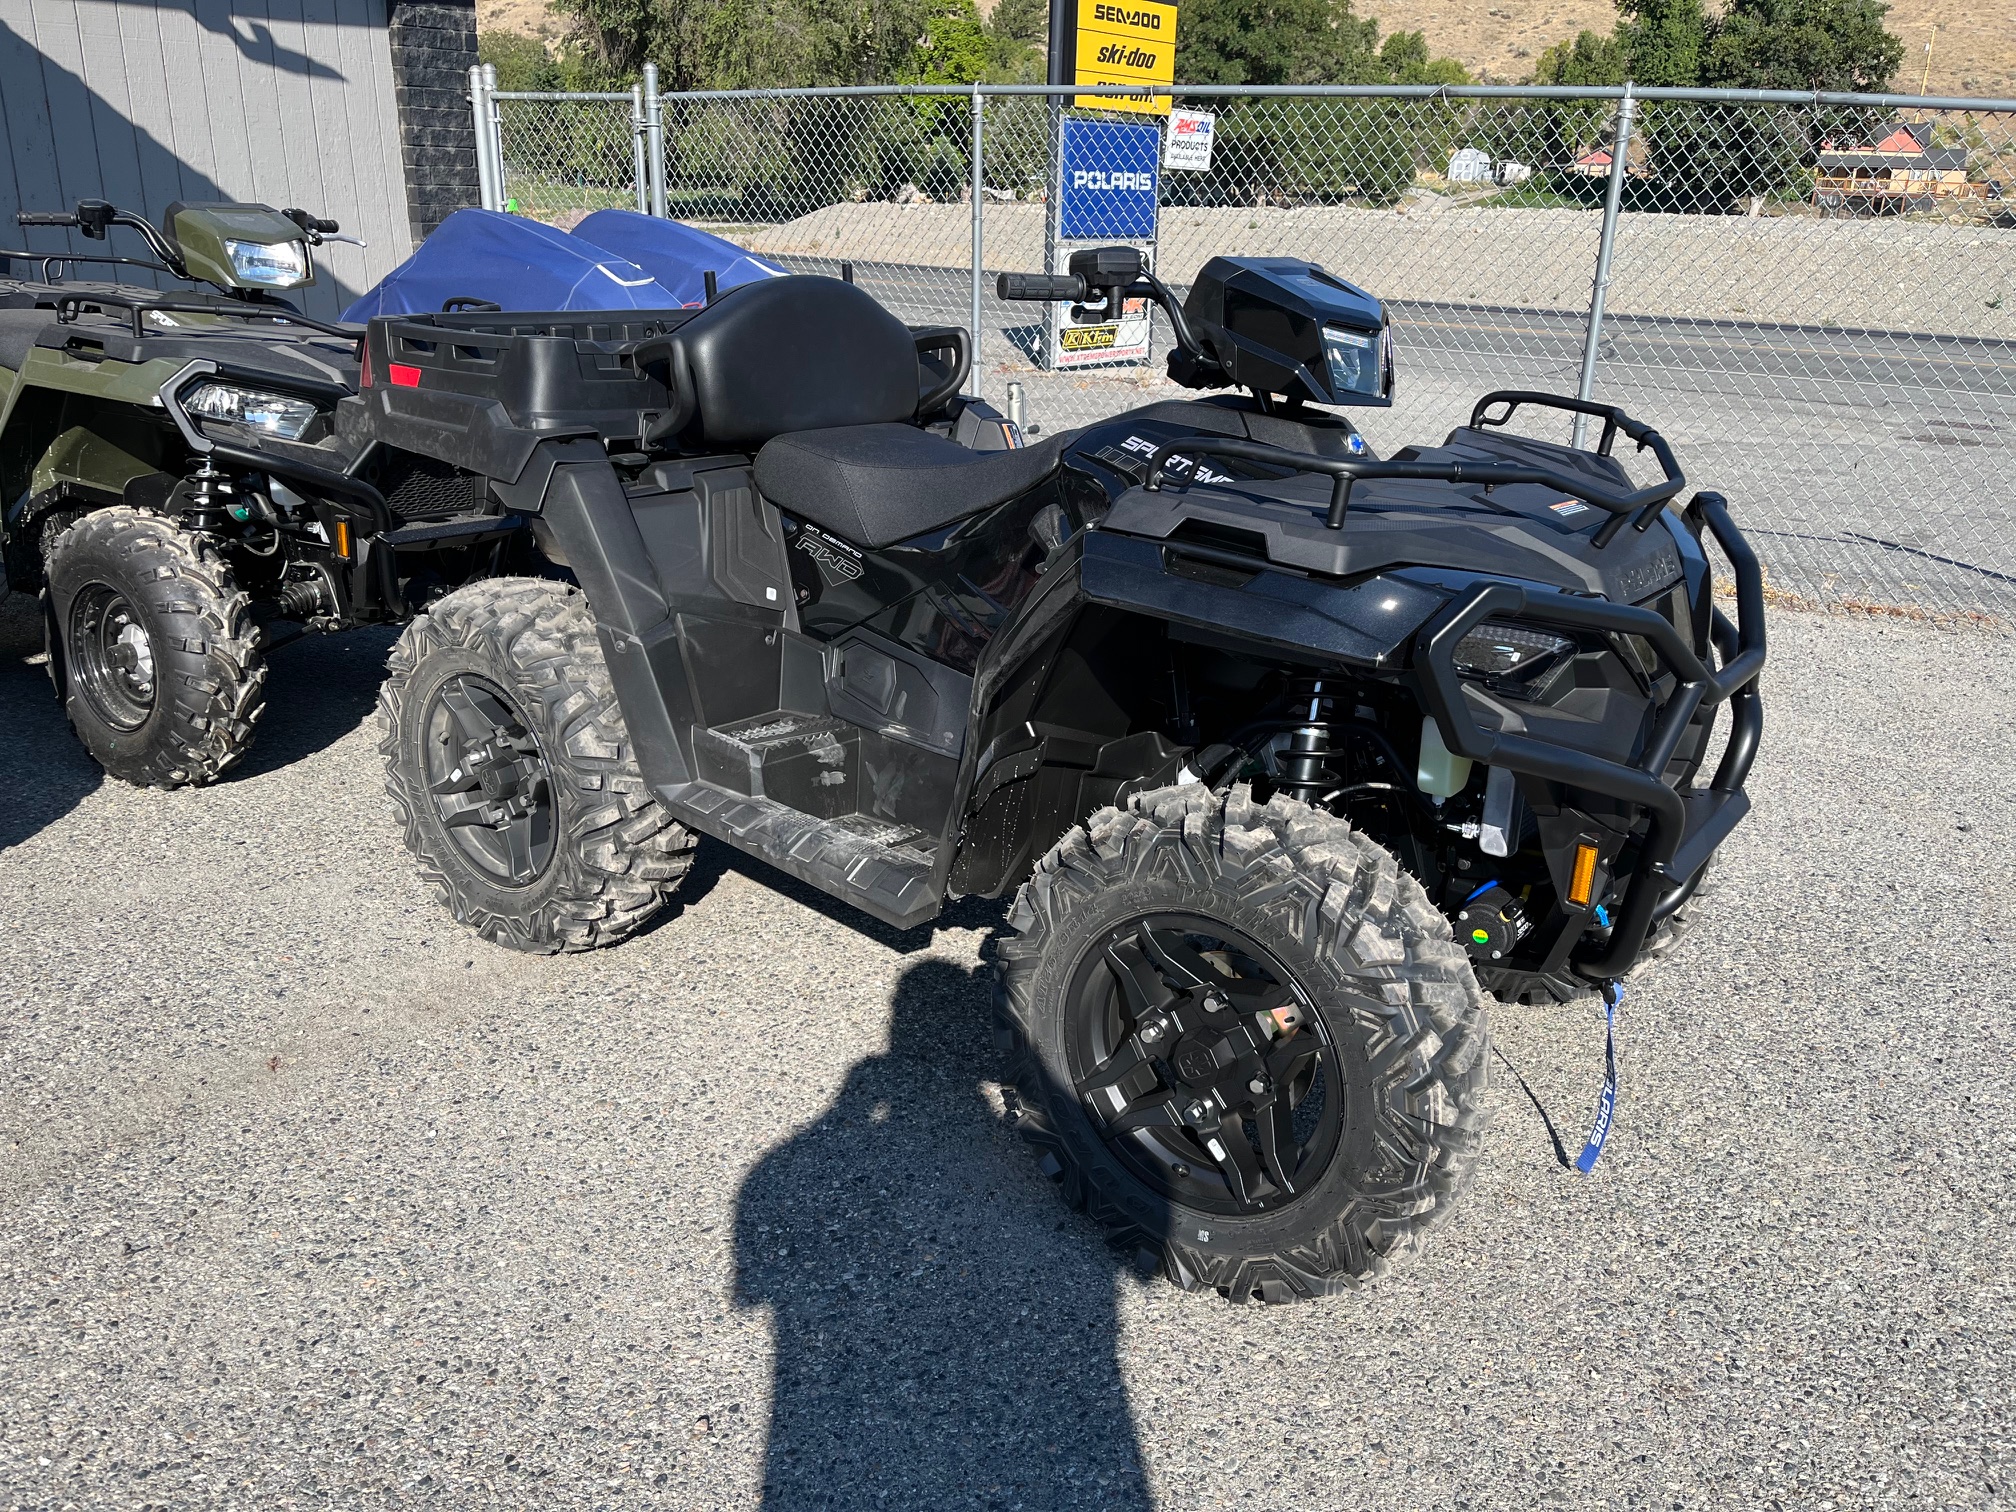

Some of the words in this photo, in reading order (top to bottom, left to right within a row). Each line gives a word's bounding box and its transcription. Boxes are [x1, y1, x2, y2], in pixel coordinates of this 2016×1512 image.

[1096, 43, 1157, 69] ski-doo
[1174, 118, 1212, 135] AMSOIL
[1171, 139, 1208, 152] PRODUCTS
[1074, 170, 1152, 191] POLARIS
[795, 536, 862, 580] AWD
[1618, 554, 1676, 597] POLARIS
